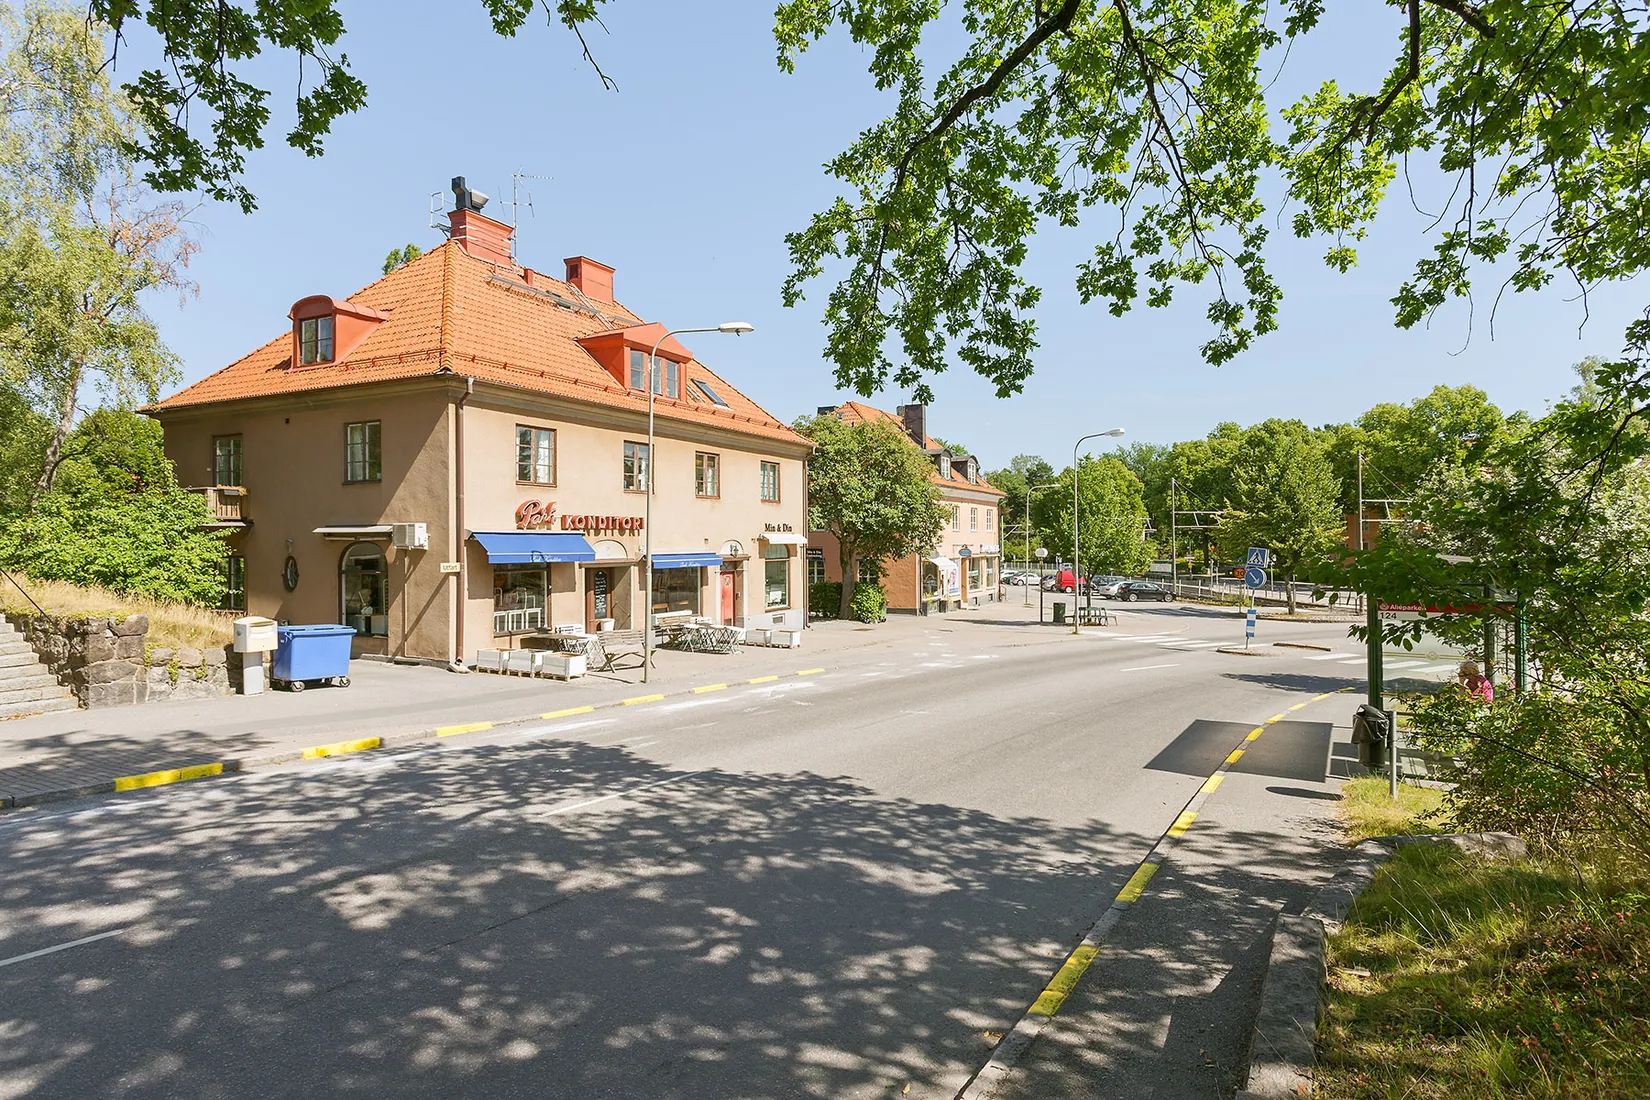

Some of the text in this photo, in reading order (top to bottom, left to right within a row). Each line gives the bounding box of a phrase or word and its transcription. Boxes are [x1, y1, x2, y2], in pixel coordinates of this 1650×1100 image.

[515, 499, 557, 528] Park
[764, 523, 793, 532] Min & Din
[1236, 569, 1245, 577] 30
[1380, 612, 1397, 620] 124
